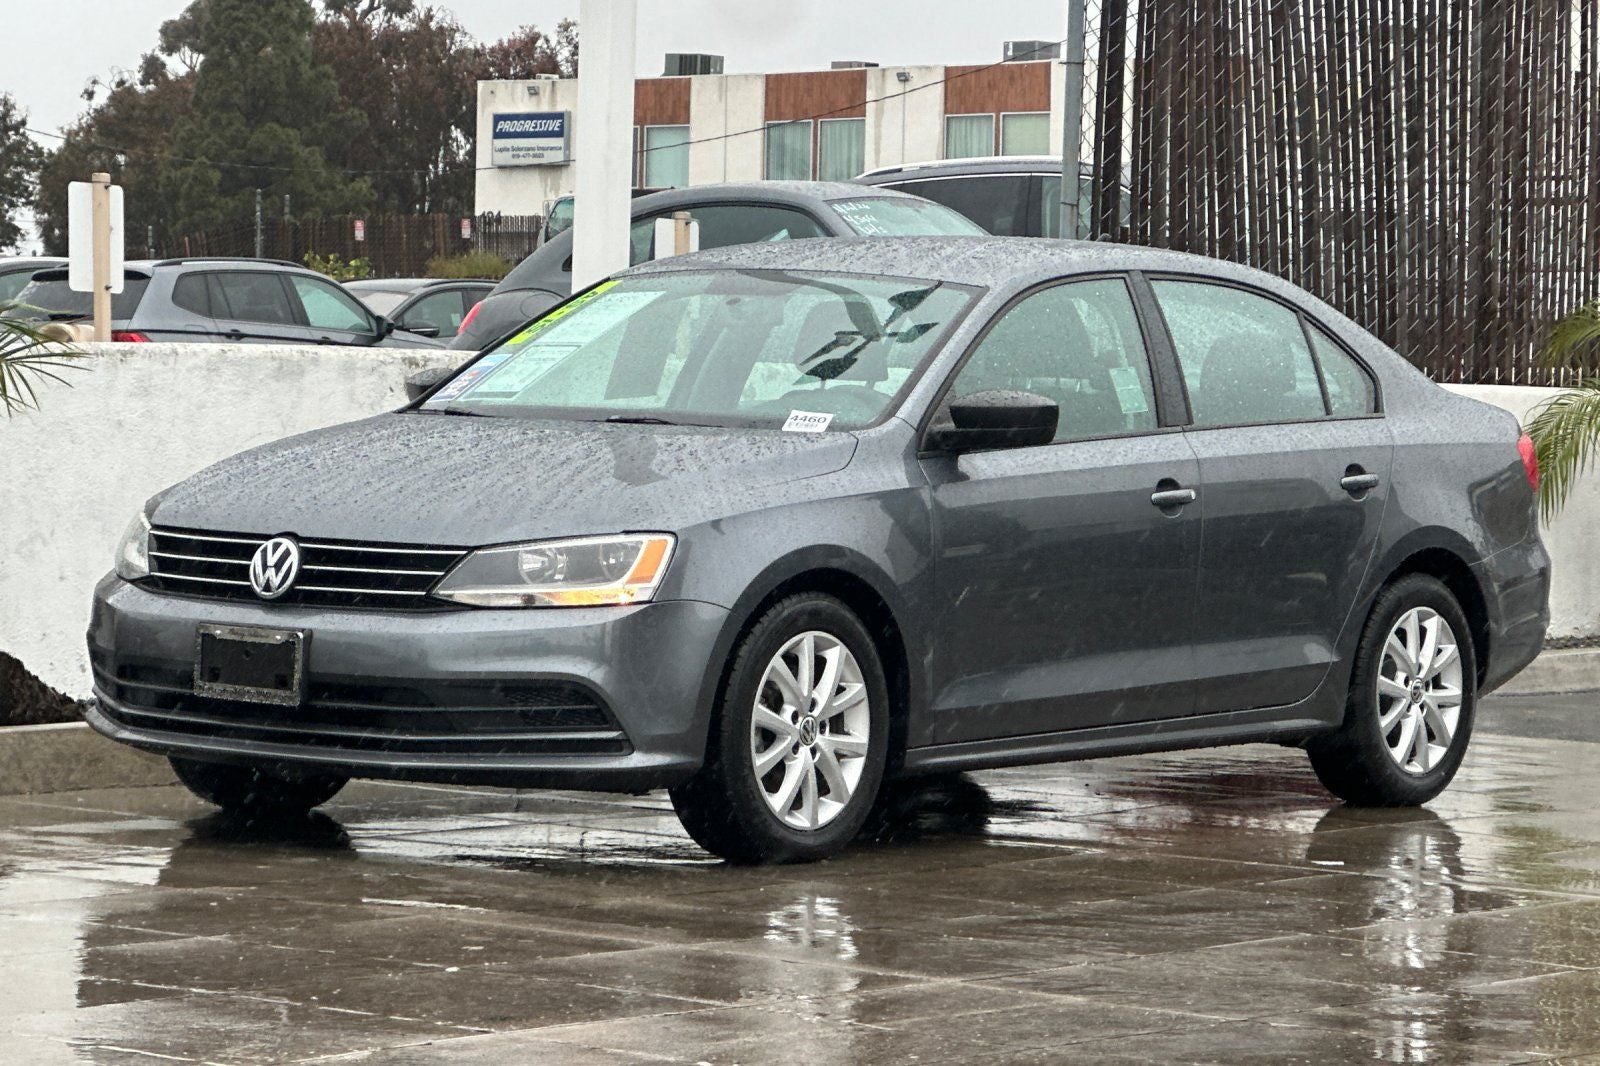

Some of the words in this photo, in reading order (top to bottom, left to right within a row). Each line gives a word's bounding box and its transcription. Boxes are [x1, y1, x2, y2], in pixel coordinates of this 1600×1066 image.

[496, 119, 562, 132] PROGRESSIVE
[790, 414, 827, 424] 4460
[250, 538, 299, 599] VW
